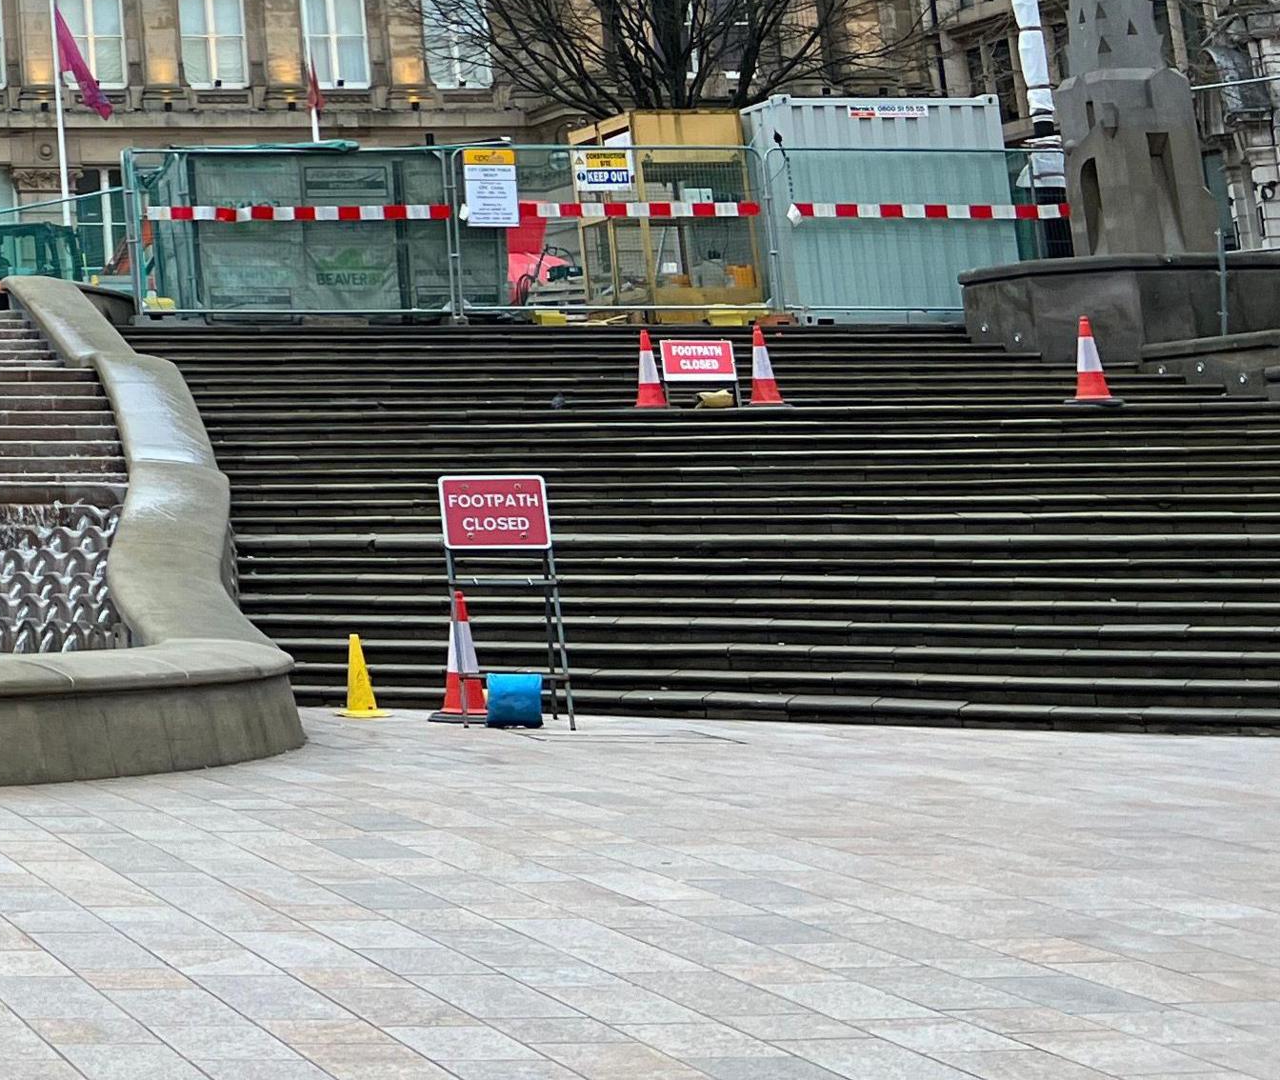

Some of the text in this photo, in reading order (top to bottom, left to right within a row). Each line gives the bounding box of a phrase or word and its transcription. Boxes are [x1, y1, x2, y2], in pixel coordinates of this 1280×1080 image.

[587, 170, 628, 182] KEEP OUT
[671, 345, 723, 357] FOOTPATH
[679, 359, 719, 370] CLOSED
[447, 493, 539, 508] FOOTPATH
[462, 517, 530, 531] CLOSED
